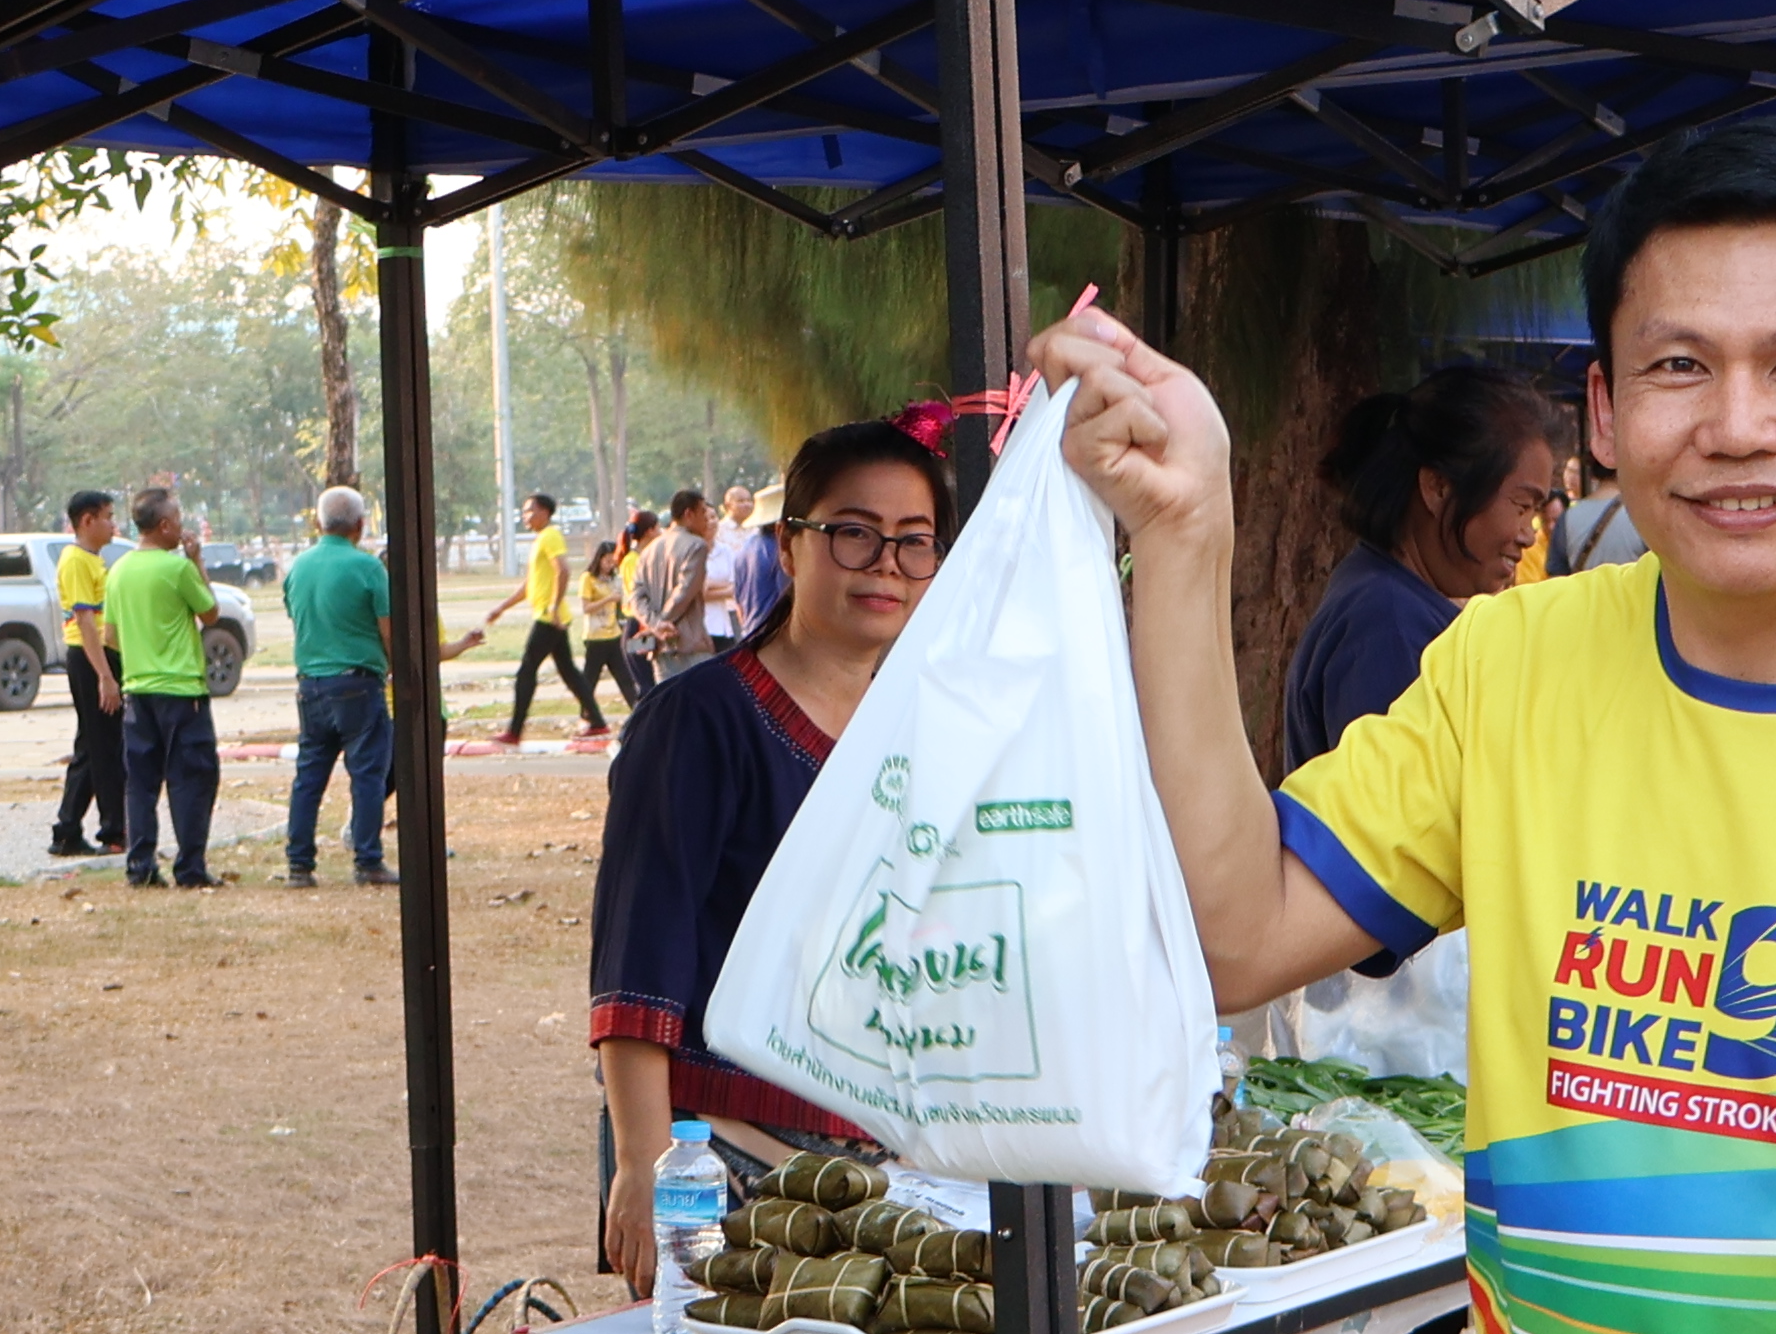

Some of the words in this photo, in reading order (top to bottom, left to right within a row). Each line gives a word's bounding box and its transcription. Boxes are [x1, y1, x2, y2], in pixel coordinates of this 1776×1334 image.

[977, 803, 1071, 829] earthsafe
[1577, 880, 1724, 941] WALK
[1553, 930, 1715, 1008] RUN
[1547, 996, 1702, 1072] BIKE
[1550, 1070, 1680, 1116] FIGHTING
